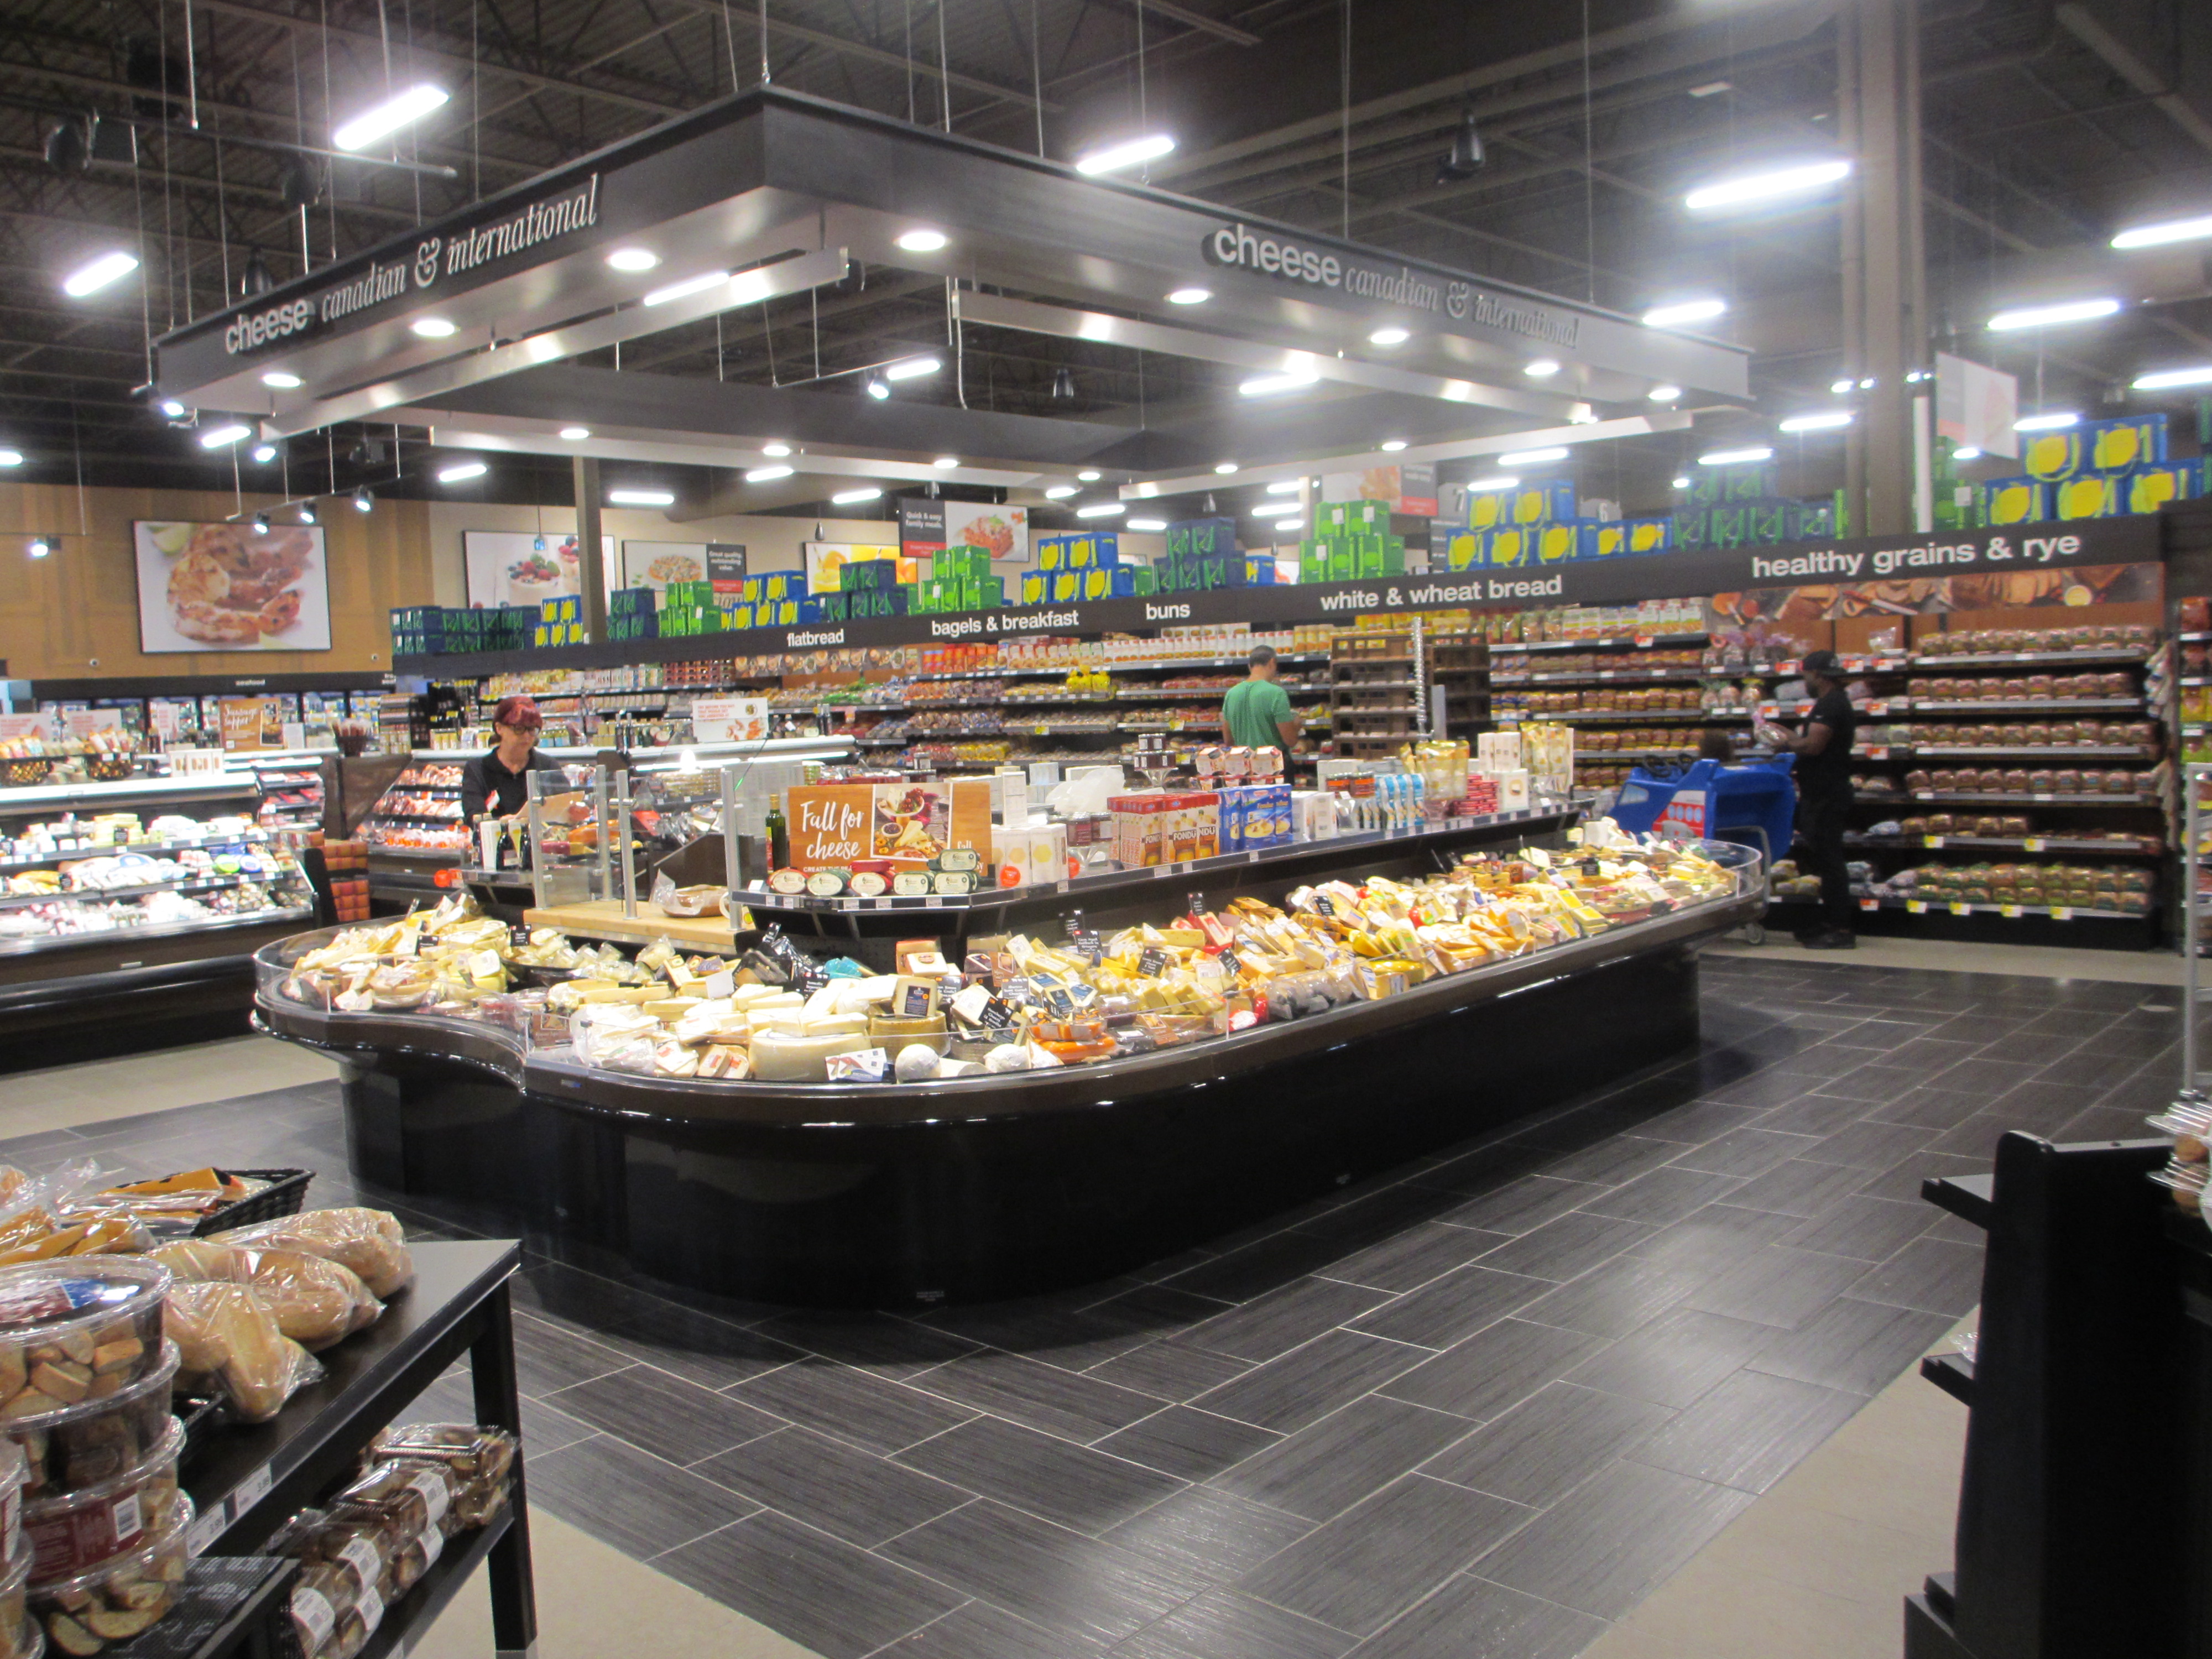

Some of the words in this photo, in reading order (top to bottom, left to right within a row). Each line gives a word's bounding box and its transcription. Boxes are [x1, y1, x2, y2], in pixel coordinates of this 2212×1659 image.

[226, 299, 310, 355] cheese
[321, 262, 407, 322] canadian
[414, 238, 441, 288] &
[446, 173, 599, 275] international
[1214, 223, 1341, 288] cheese
[1345, 268, 1439, 312] canadian
[1446, 281, 1469, 319] &
[1474, 293, 1580, 349] international
[1751, 551, 1864, 578] healthy
[1873, 542, 1976, 575] grains
[1986, 536, 2013, 560] &
[2022, 535, 2080, 562] rye
[1319, 590, 1379, 611] white
[1386, 587, 1404, 606] &
[1408, 583, 1482, 605] wheat
[1488, 574, 1563, 599] bread
[932, 617, 982, 638] bagels
[986, 617, 998, 632] &
[1001, 611, 1079, 632] breakfast
[1146, 603, 1191, 620] buns
[787, 629, 845, 647] flatbread
[800, 800, 837, 832] Fall
[839, 802, 863, 841] for
[806, 832, 861, 860] cheese
